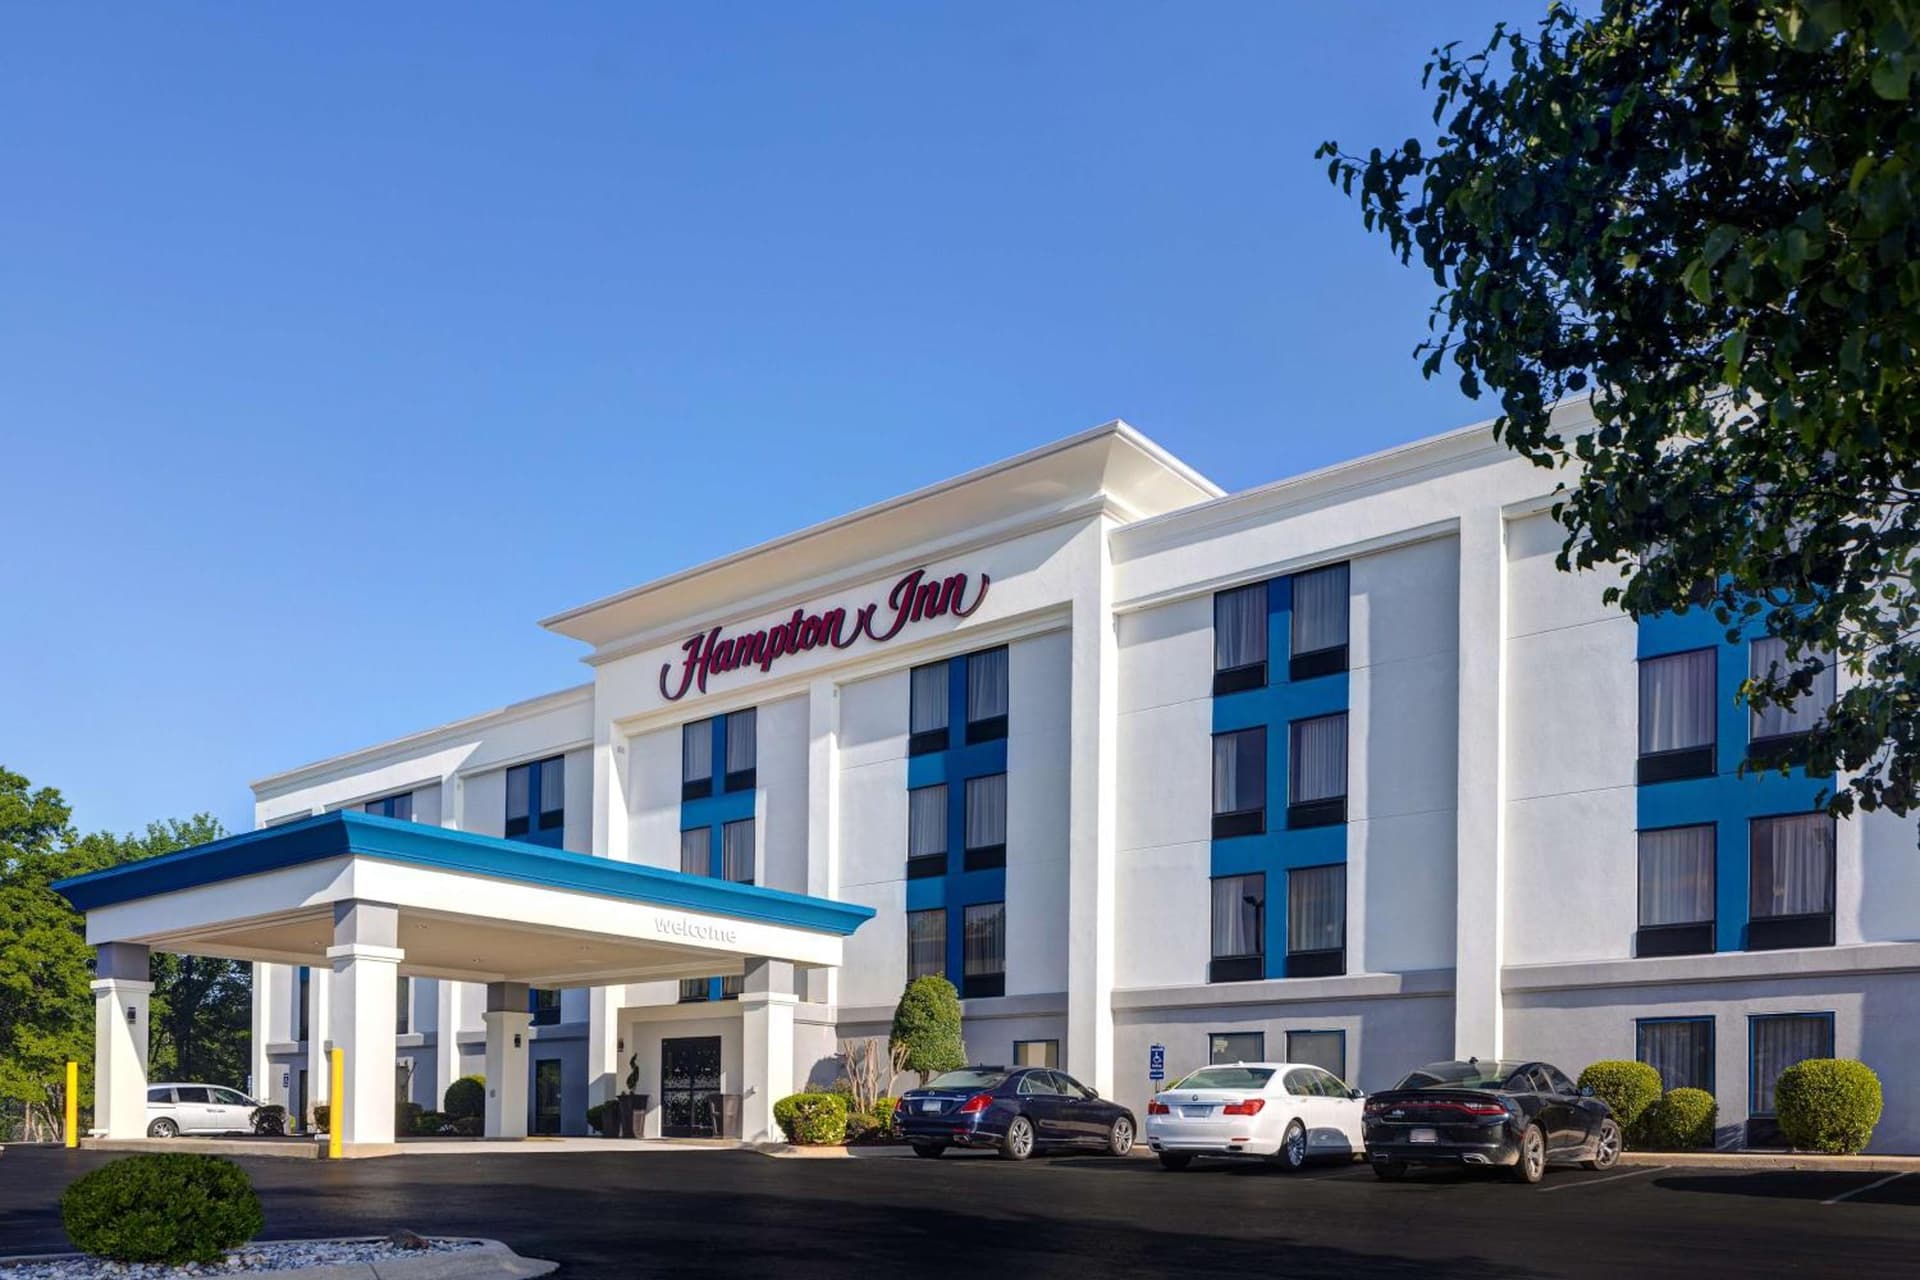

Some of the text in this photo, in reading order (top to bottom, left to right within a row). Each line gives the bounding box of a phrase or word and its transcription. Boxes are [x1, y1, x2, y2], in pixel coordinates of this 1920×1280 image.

[659, 568, 990, 701] Hampton Inn
[654, 917, 737, 944] welcome
